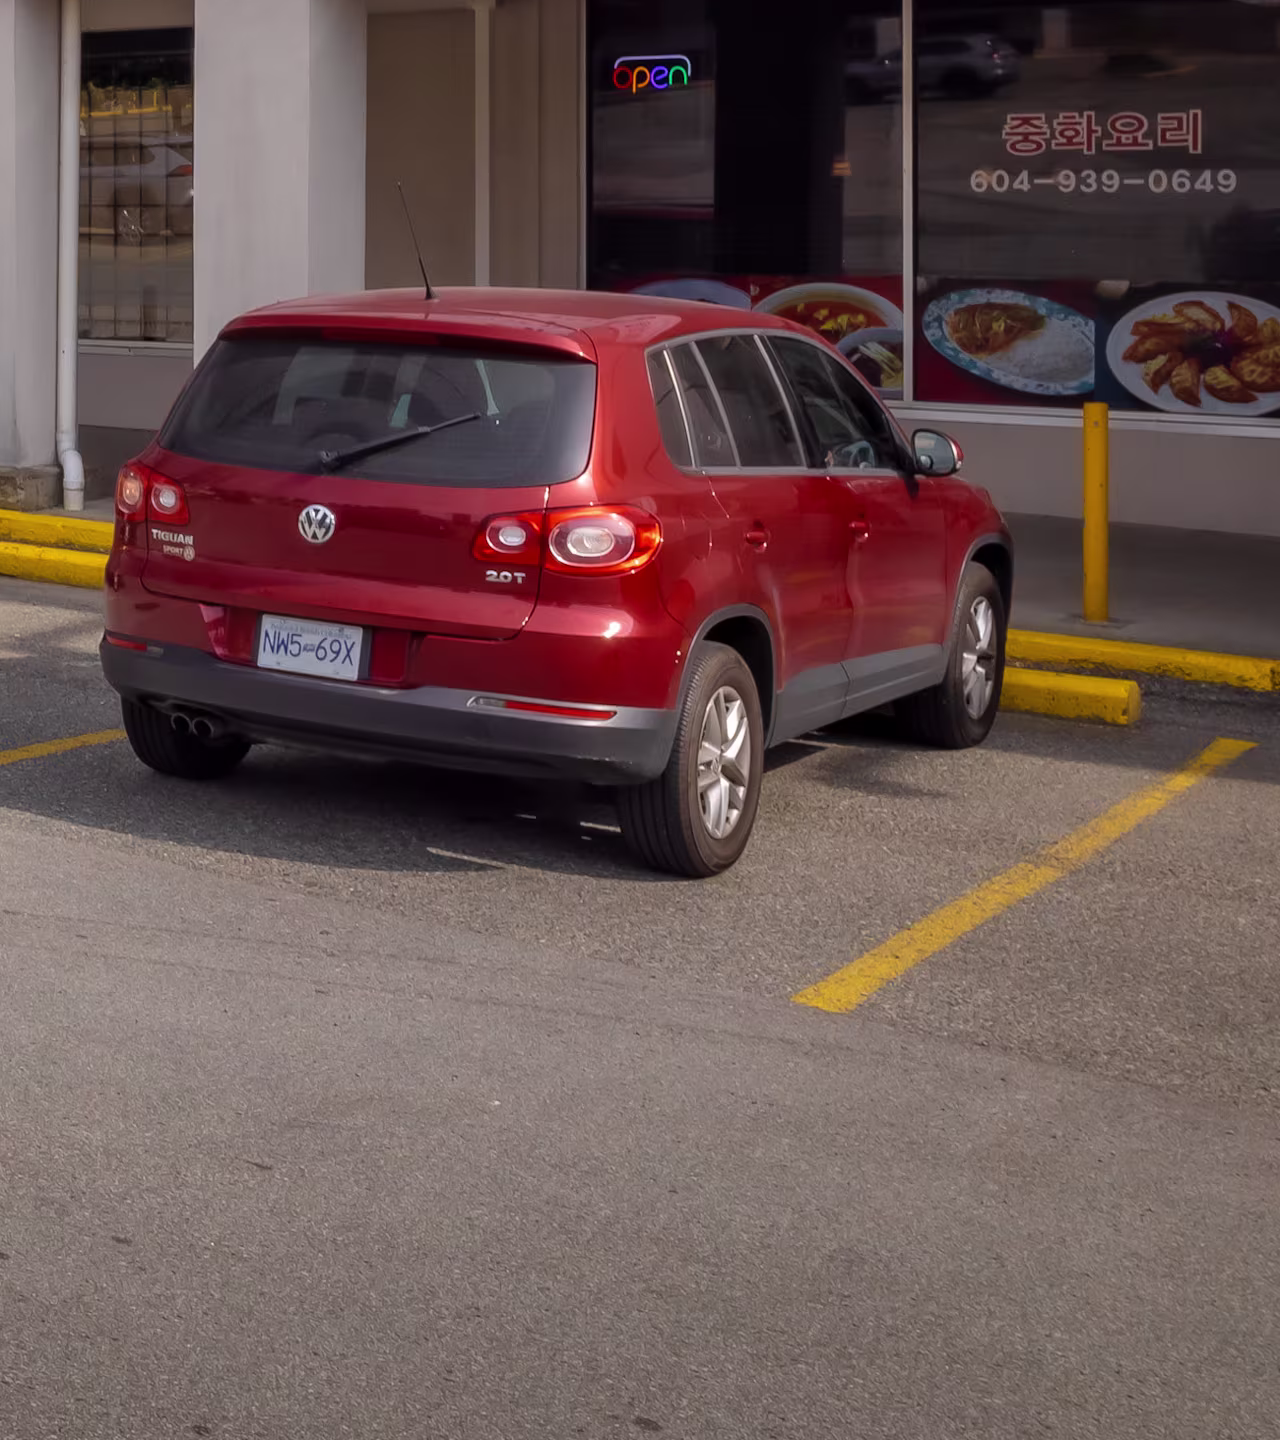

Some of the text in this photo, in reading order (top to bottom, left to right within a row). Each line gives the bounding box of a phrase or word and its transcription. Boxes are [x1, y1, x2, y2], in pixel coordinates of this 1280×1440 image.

[613, 65, 688, 95] open
[1002, 109, 1203, 156] 중화요리
[970, 168, 1238, 193] 604-939-0649
[151, 528, 194, 545] TIGUAN
